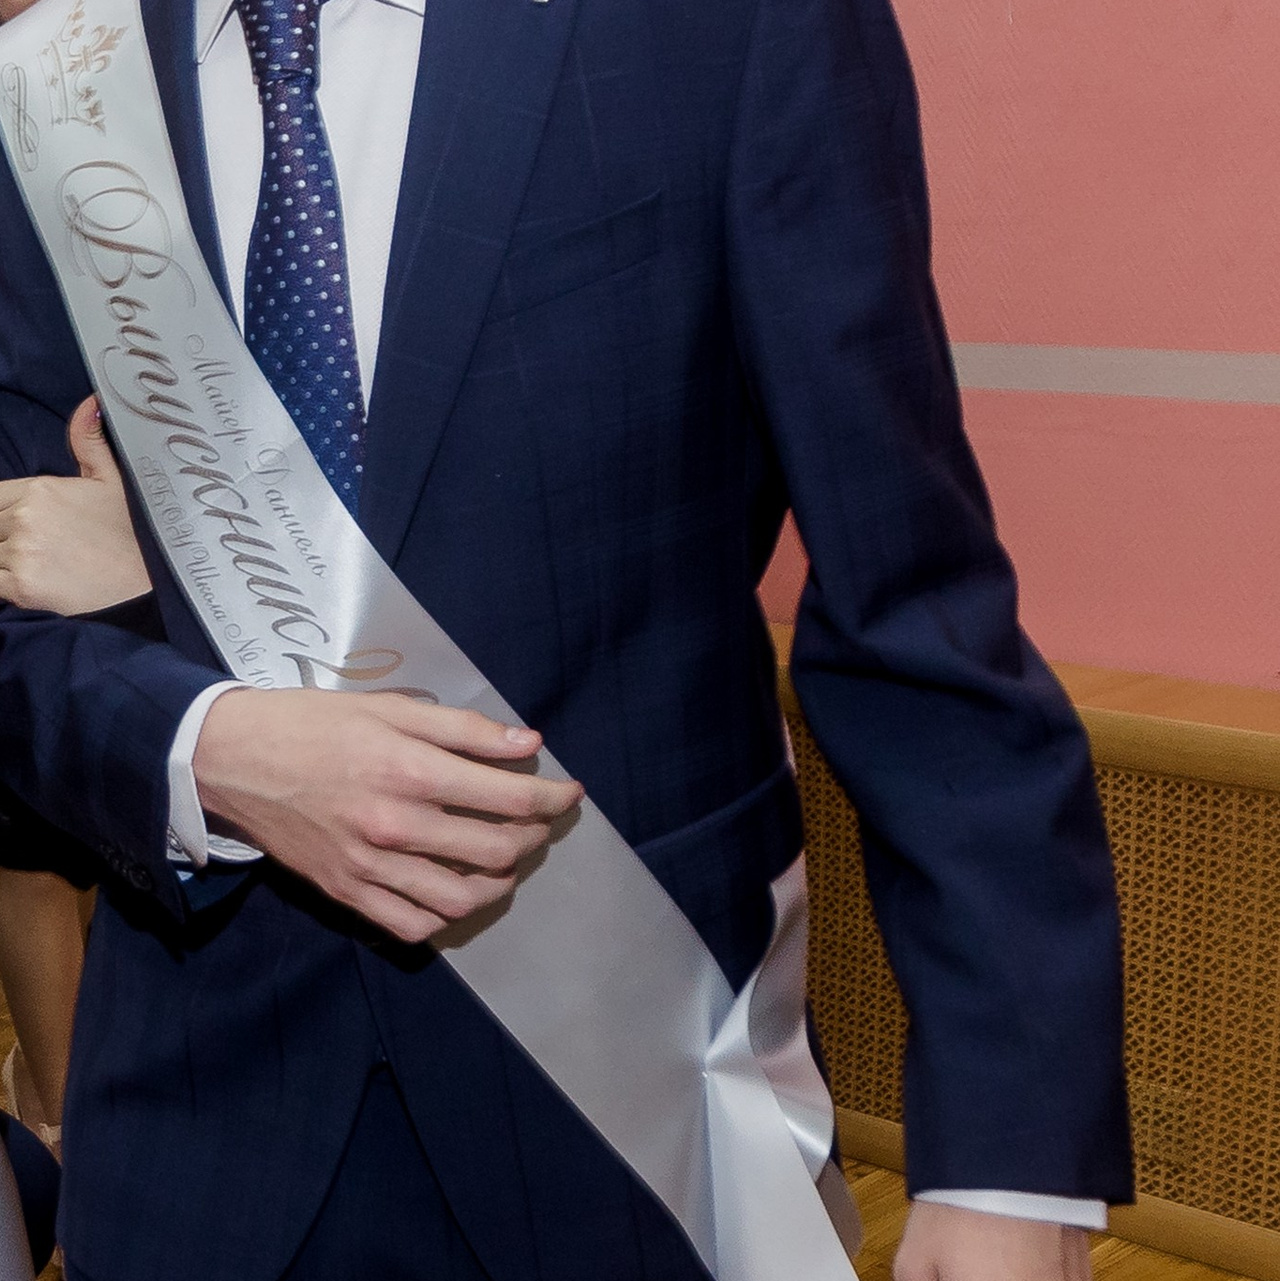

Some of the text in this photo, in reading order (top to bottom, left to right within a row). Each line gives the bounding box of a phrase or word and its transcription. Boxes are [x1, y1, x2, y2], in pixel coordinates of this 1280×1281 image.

[55, 160, 331, 648] Выпускник
[185, 333, 327, 579] Майер Даниель
[186, 544, 227, 621] Школа
[223, 623, 266, 665] №
